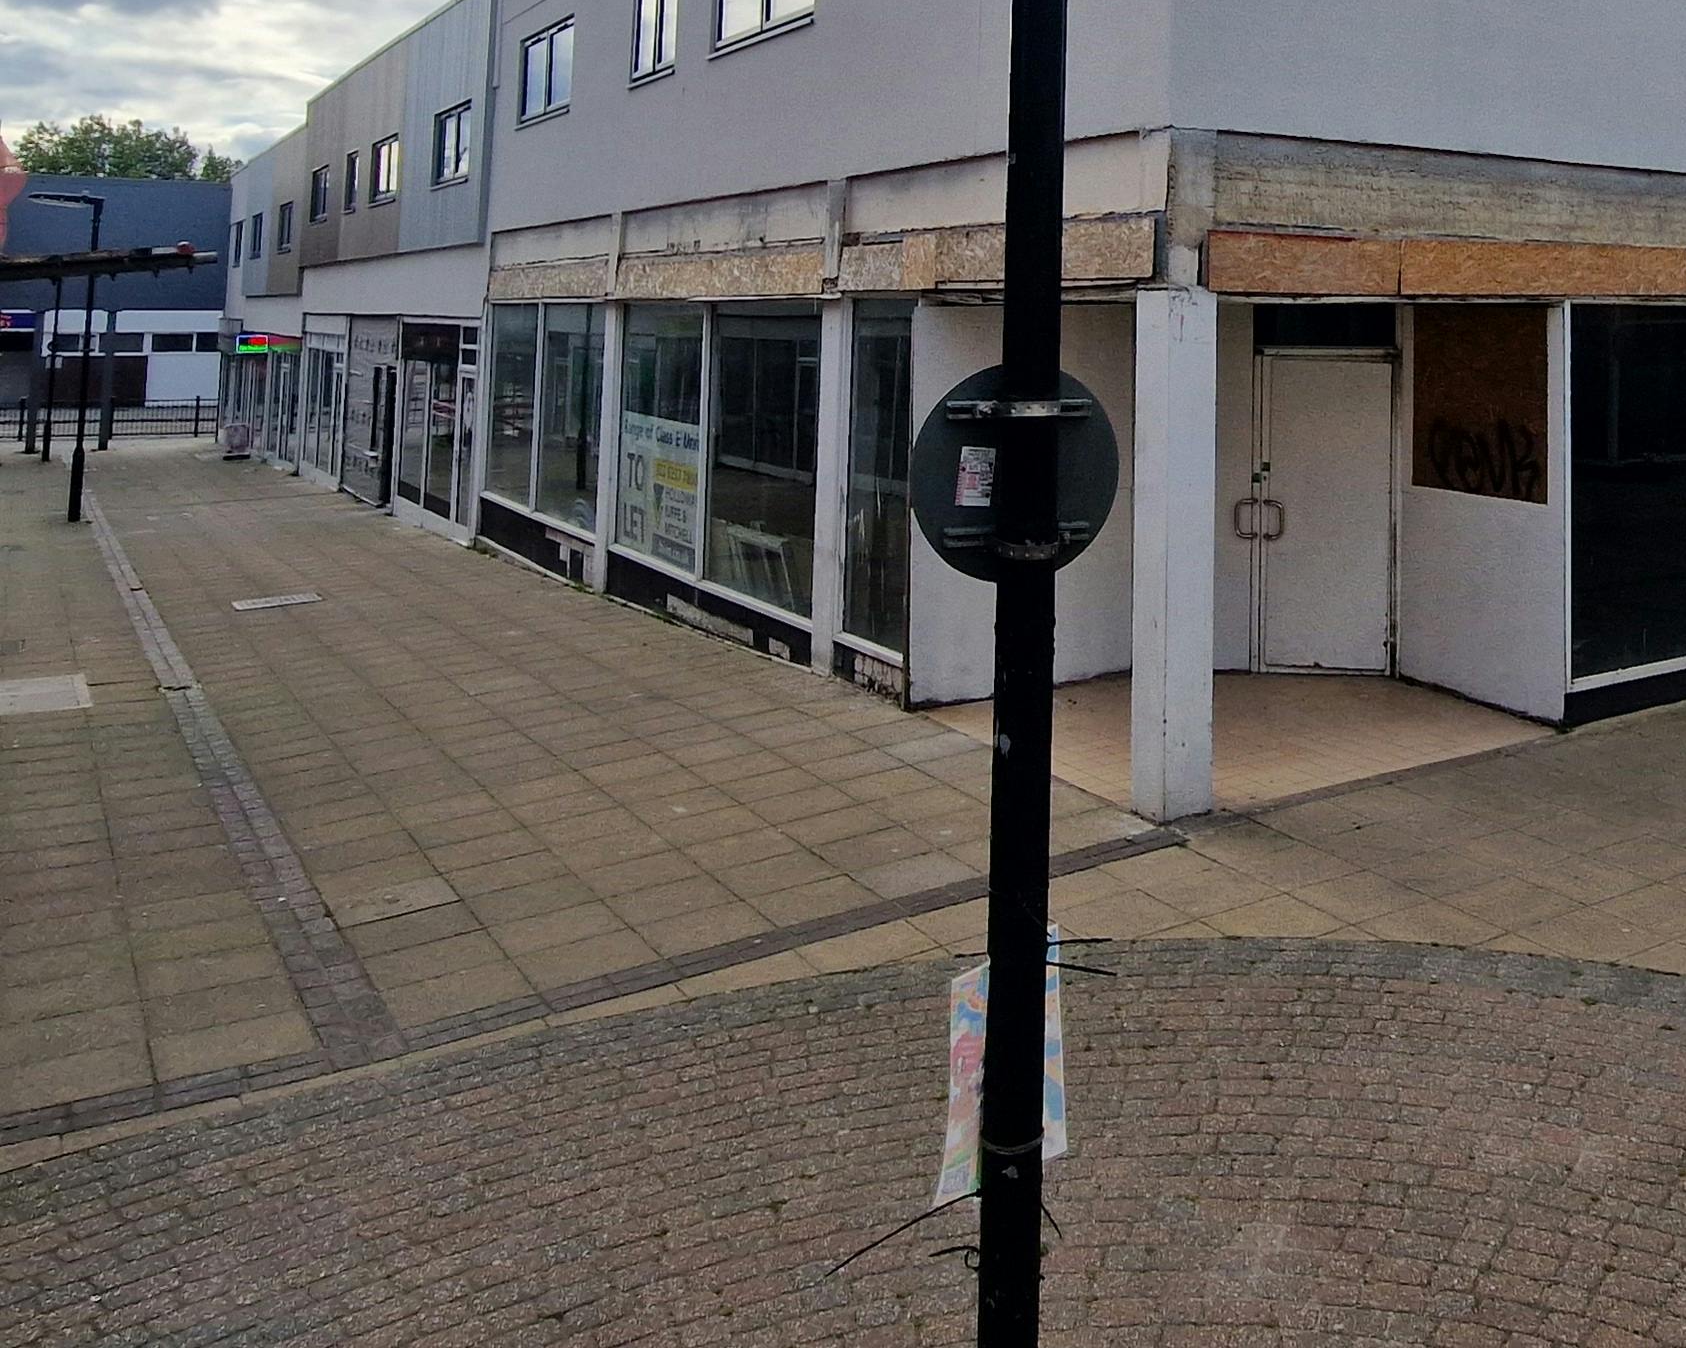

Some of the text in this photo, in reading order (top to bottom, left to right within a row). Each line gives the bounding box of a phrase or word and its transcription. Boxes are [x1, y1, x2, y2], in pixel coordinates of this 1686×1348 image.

[656, 425, 673, 446] Class
[627, 452, 644, 491] TO
[623, 501, 647, 545] LET
